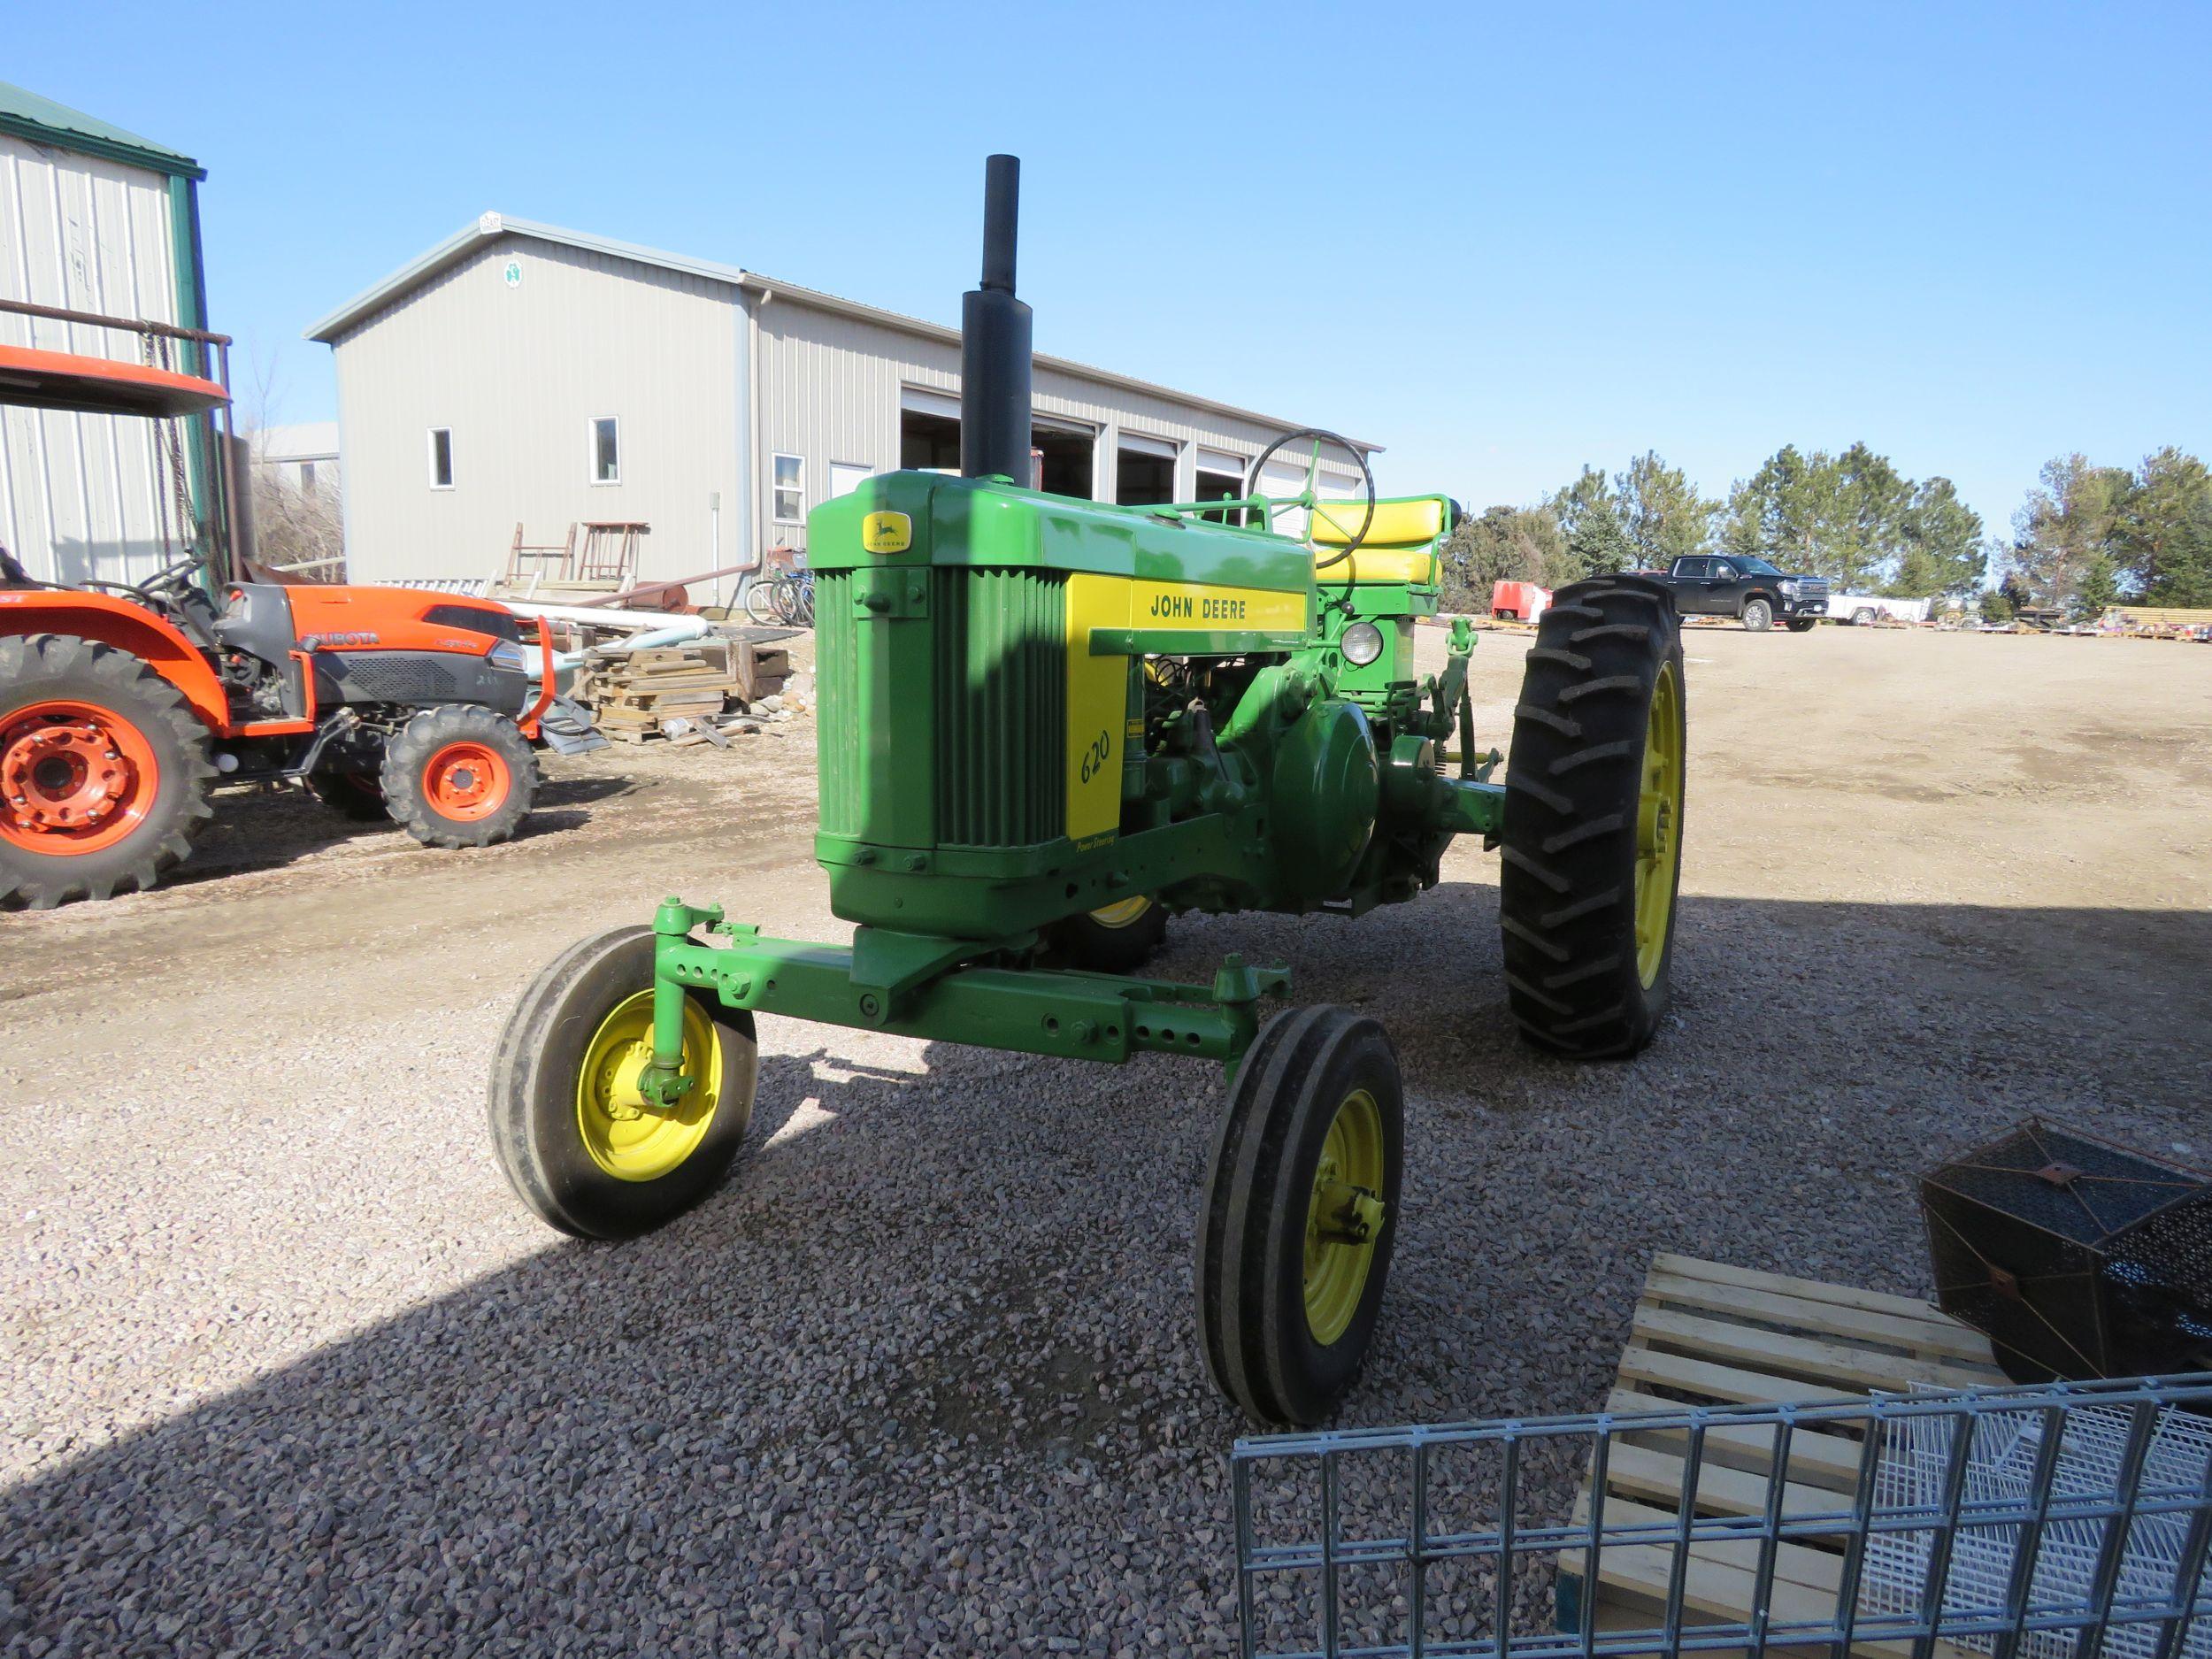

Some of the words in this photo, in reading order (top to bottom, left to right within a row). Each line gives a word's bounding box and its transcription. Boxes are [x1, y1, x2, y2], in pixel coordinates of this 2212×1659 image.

[1151, 595, 1192, 618] JOHN
[1203, 598, 1245, 619] DEERE
[1081, 729, 1110, 785] 620
[1076, 841, 1093, 854] Power
[1094, 836, 1115, 849] Steering
